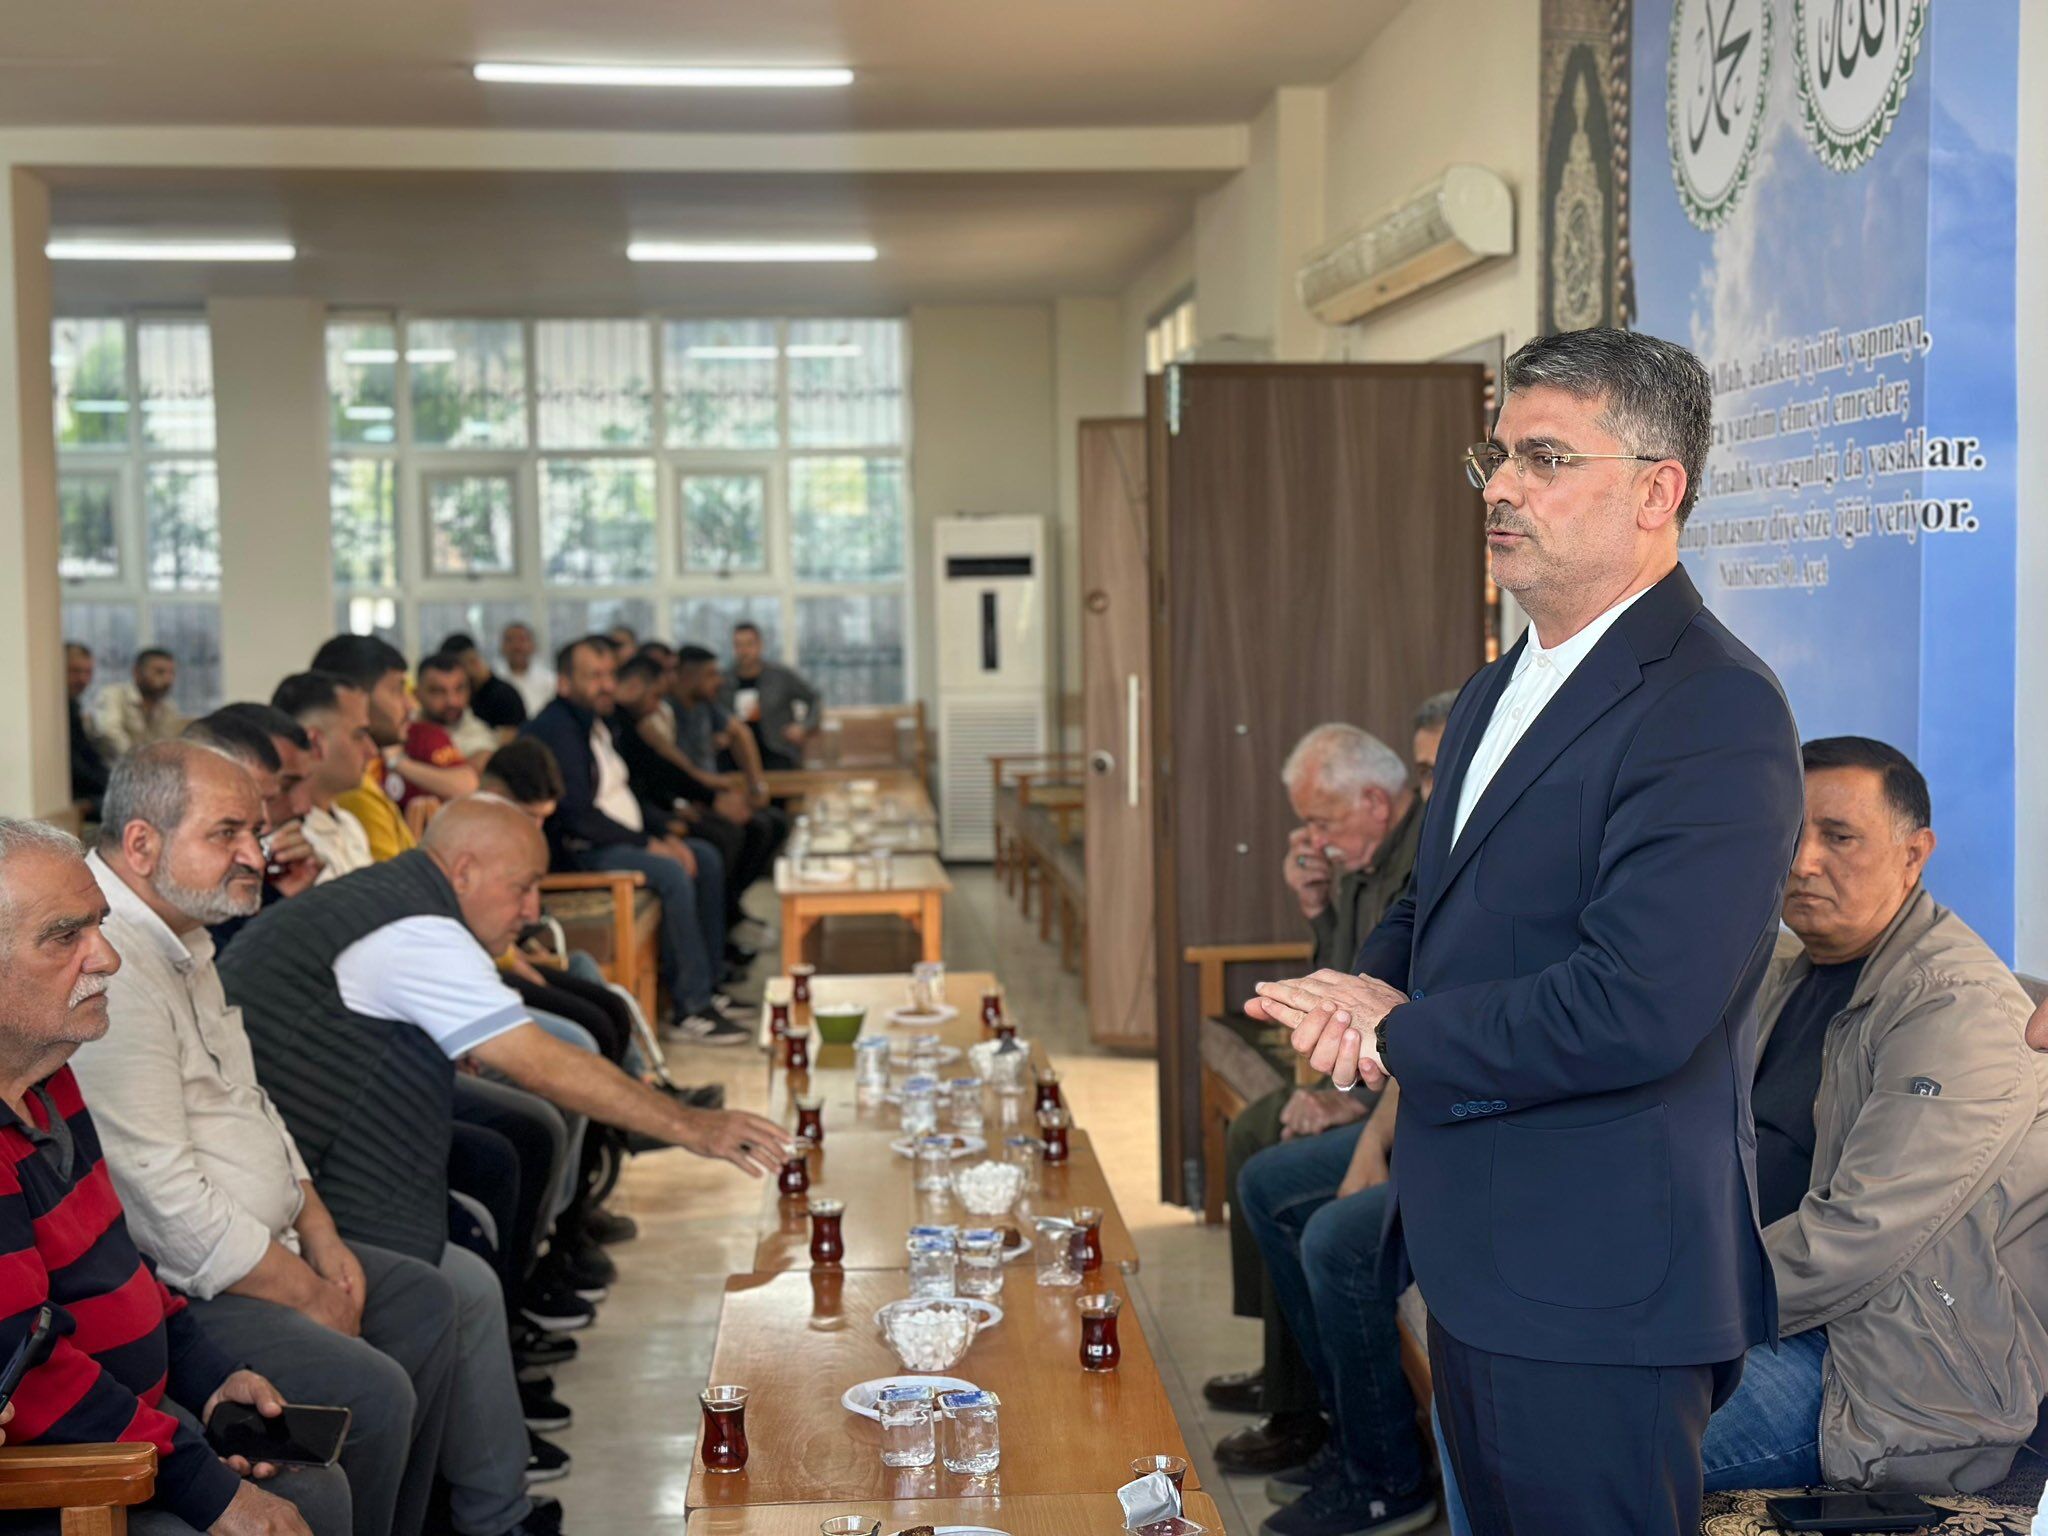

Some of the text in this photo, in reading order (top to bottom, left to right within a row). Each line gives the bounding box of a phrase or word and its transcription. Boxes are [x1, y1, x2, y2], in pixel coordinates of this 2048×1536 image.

[1804, 329, 1843, 384] iyilik
[1847, 318, 1932, 375] yapmayı,
[1728, 405, 1776, 452] yardım
[1779, 388, 1829, 438] etmeyi
[1833, 376, 1909, 424] emreder;
[1756, 465, 1773, 490] ve
[1844, 439, 1862, 478] da
[1866, 428, 1985, 486] yasaklar.
[1770, 505, 1799, 550] diye
[1803, 504, 1830, 538] size
[1836, 499, 1871, 547] öğüt
[1876, 493, 1979, 543] veriyor.
